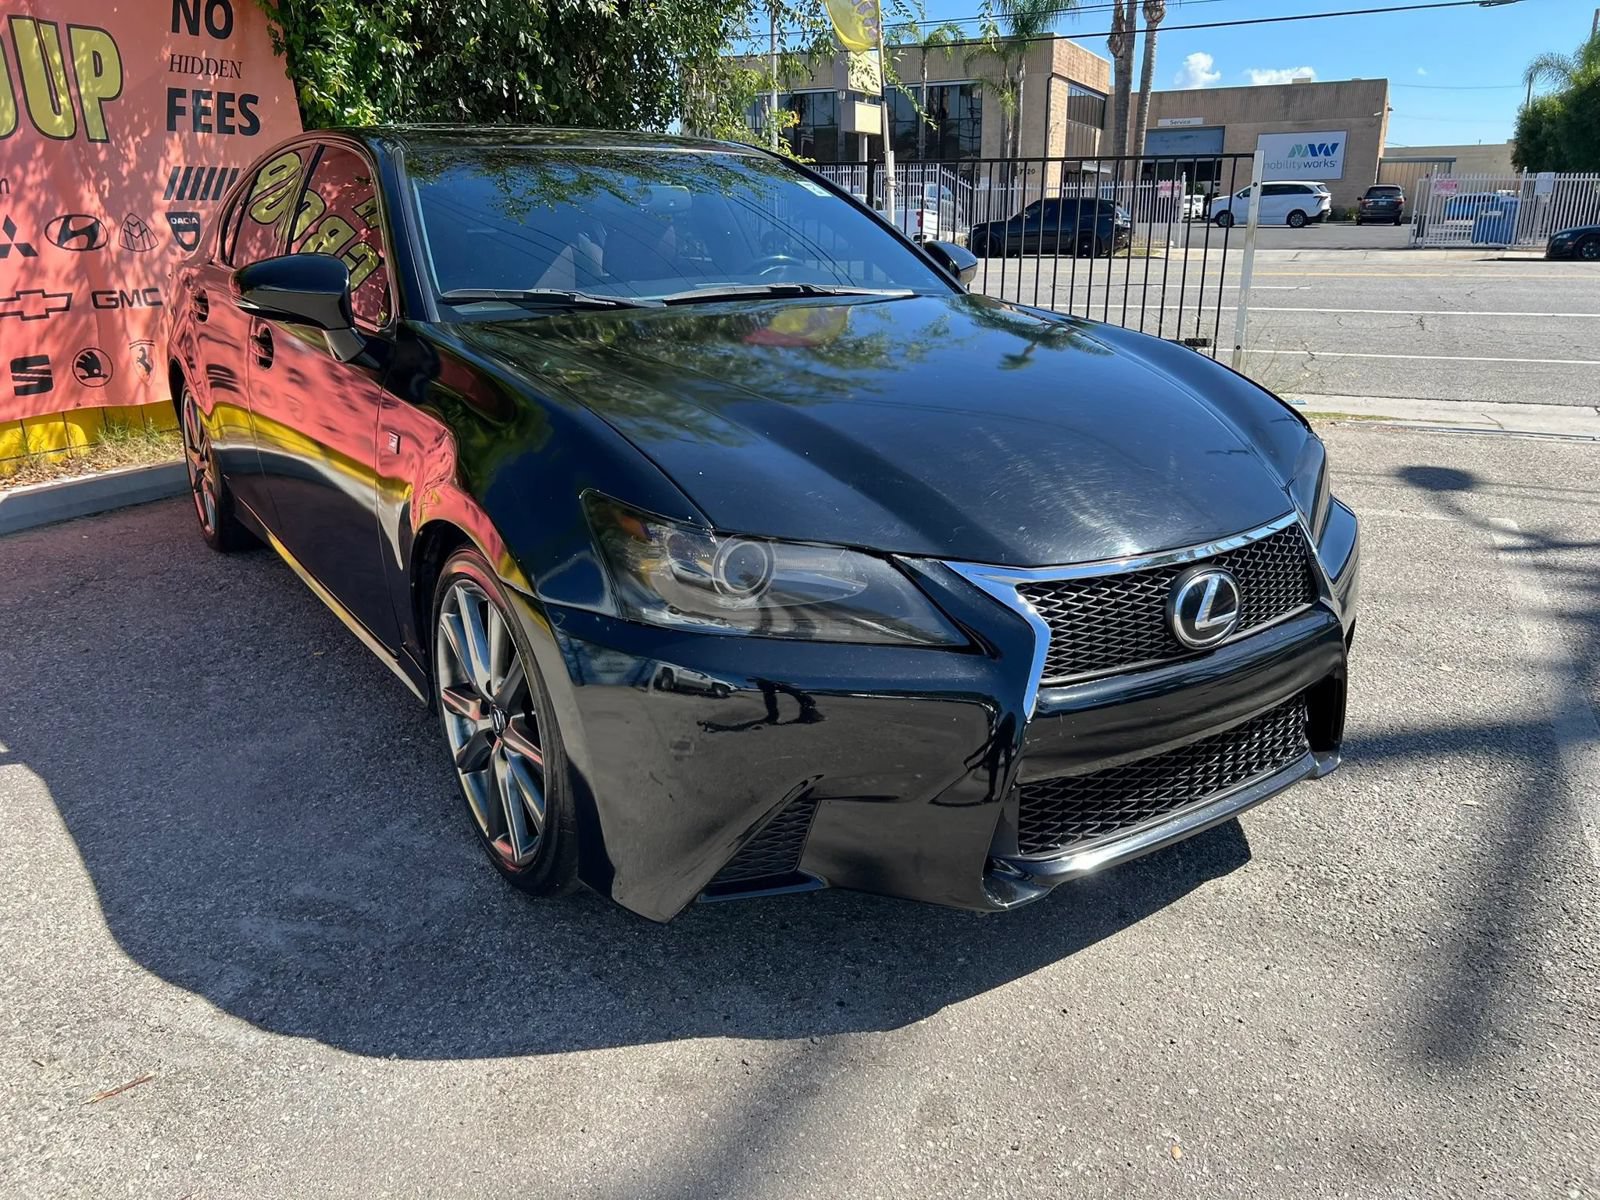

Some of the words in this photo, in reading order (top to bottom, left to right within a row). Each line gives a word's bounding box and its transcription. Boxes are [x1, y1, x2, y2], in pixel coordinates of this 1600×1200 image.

[171, 0, 234, 40] NO
[169, 53, 243, 79] HIDDEN
[166, 87, 261, 136] FEES
[170, 217, 199, 225] DACIA
[91, 287, 163, 310] GMC
